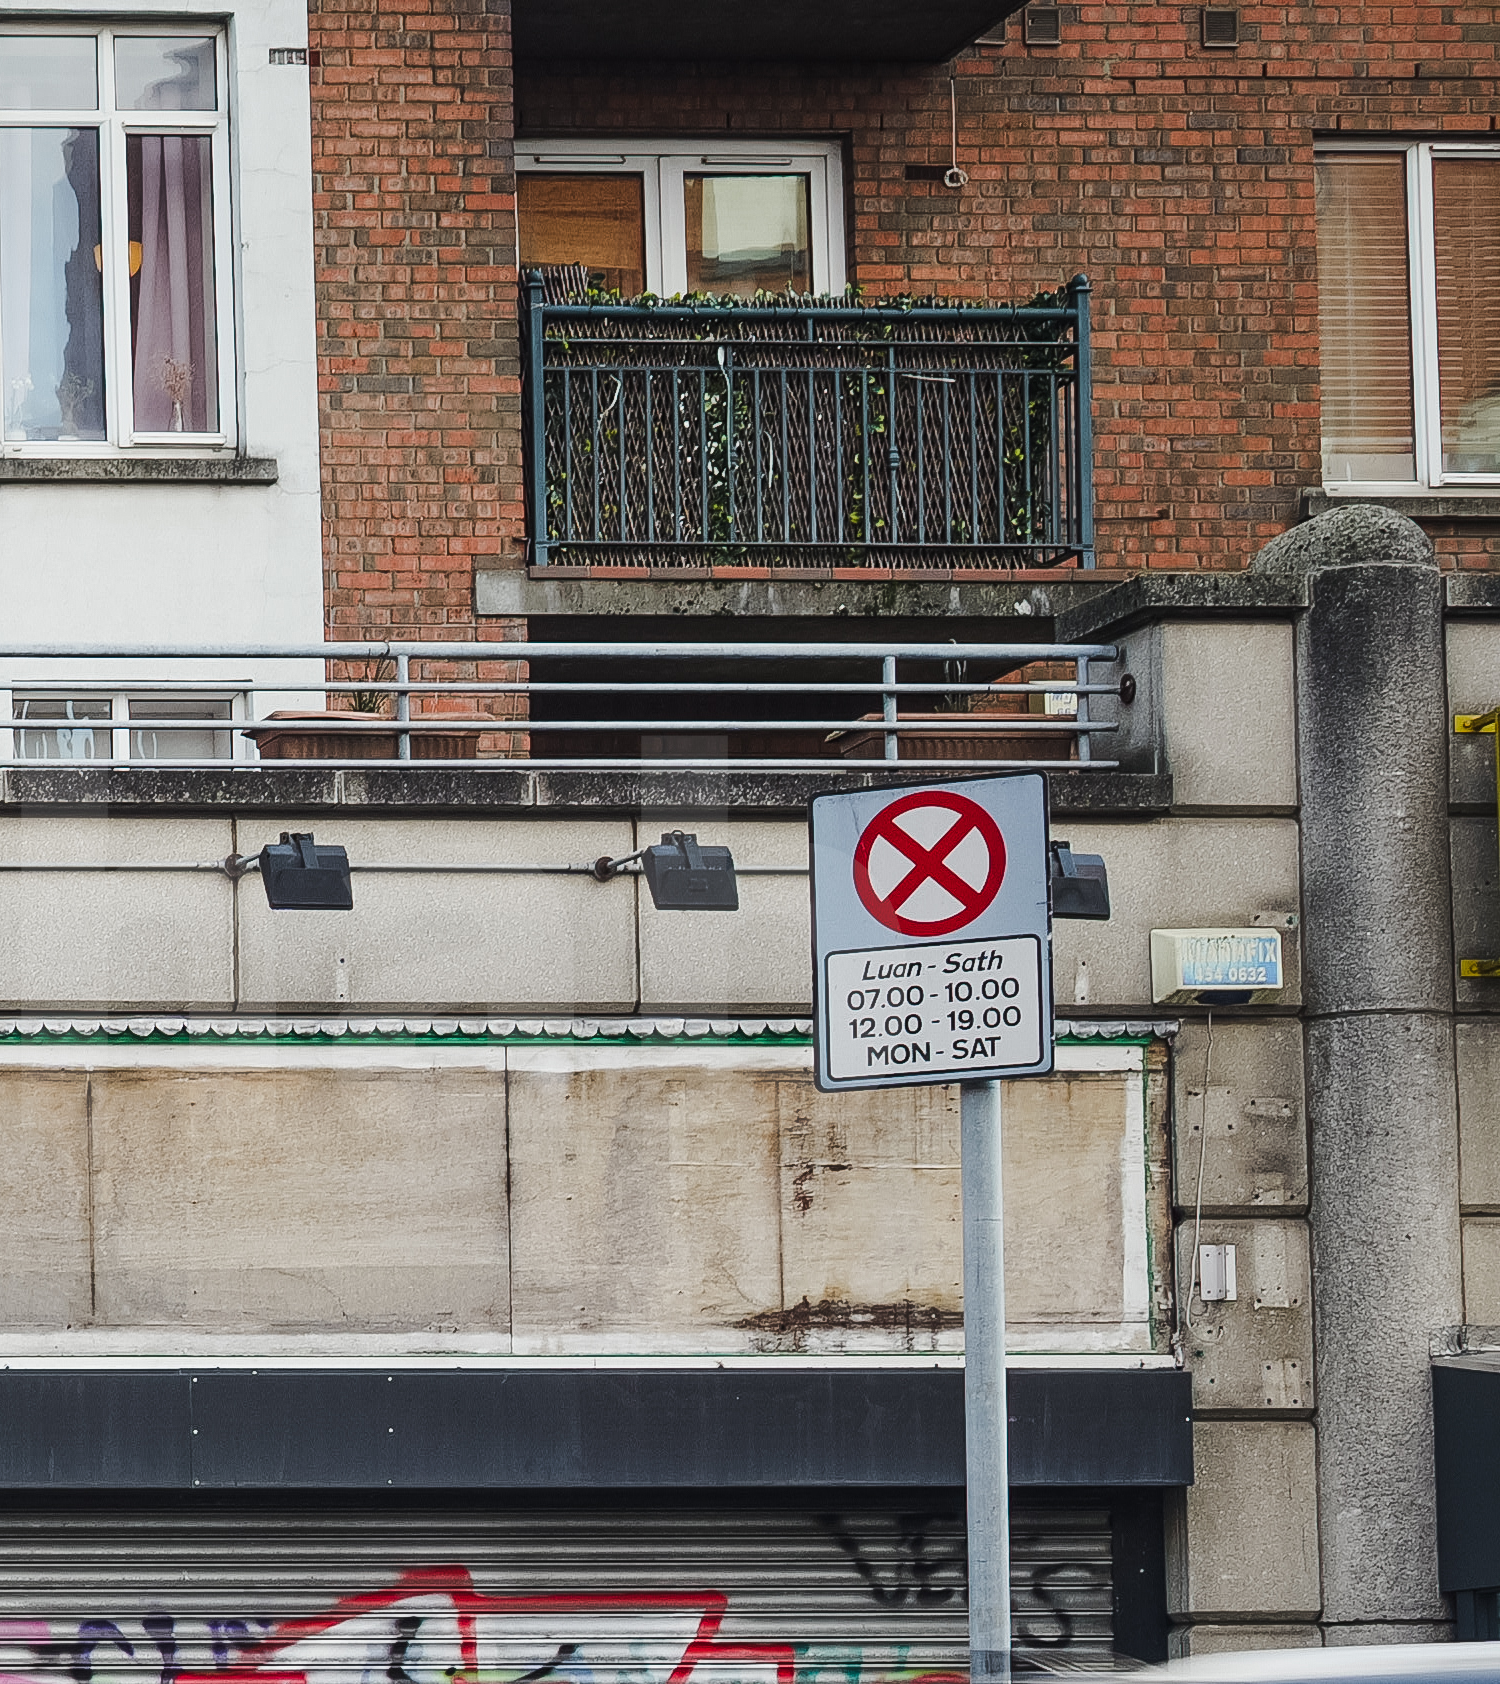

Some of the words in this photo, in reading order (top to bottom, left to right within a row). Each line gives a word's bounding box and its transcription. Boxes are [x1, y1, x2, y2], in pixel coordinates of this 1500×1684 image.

[861, 960, 923, 982] Luan
[942, 949, 1004, 975] Sath
[846, 985, 925, 1011] 07.00
[944, 977, 1021, 1003] 10.00
[849, 1013, 923, 1039] 12.00
[946, 1005, 1022, 1032] 19.00
[867, 1041, 931, 1067] MON
[952, 1036, 1002, 1060] SAT
